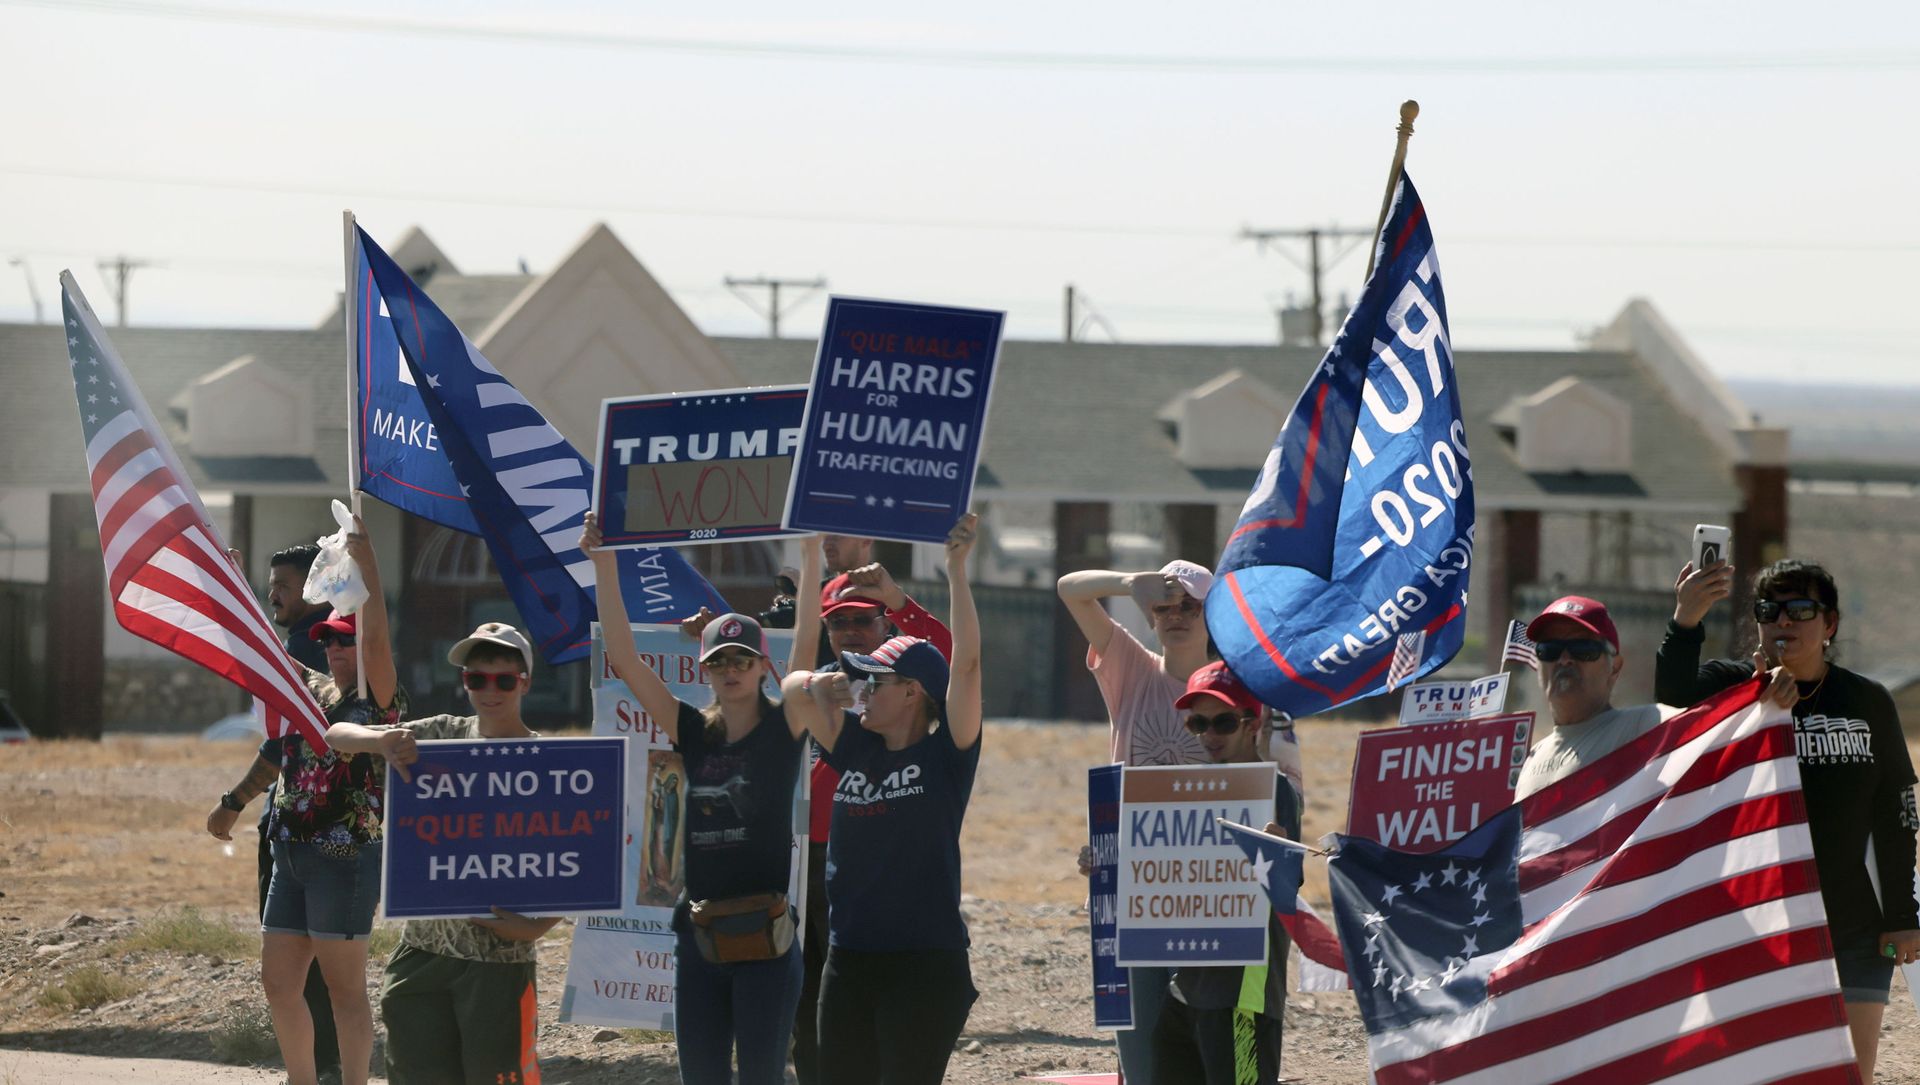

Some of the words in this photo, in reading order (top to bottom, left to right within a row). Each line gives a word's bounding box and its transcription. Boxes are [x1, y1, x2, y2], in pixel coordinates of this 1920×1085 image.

[830, 357, 977, 399] HARRIS
[866, 393, 899, 408] FOR
[372, 408, 439, 451] MAKE
[819, 411, 967, 452] HUMAN
[817, 451, 960, 480] TRAFFICKING
[652, 464, 770, 527] WON
[689, 528, 718, 540] 2020
[1413, 681, 1499, 703] TRUMP
[1419, 697, 1489, 712] PENCE
[1377, 736, 1503, 782] FINISH
[1798, 756, 1860, 765] ACKSON
[415, 773, 479, 799] SAY
[488, 771, 539, 797] NO
[549, 769, 594, 795] TO
[836, 764, 922, 802] TRUMP
[885, 786, 924, 799] GREAT!
[1414, 780, 1455, 802] THE
[1131, 808, 1252, 847] KAMALA
[1092, 833, 1118, 867] HARRI
[429, 852, 581, 880] HARRIS
[1131, 859, 1182, 884] YOUR
[1128, 895, 1144, 918] IS
[1149, 893, 1257, 918] COMPLICITY
[587, 916, 662, 932] DEMOCRATS
[593, 979, 641, 1001] VOTE
[646, 984, 674, 1003] RE
